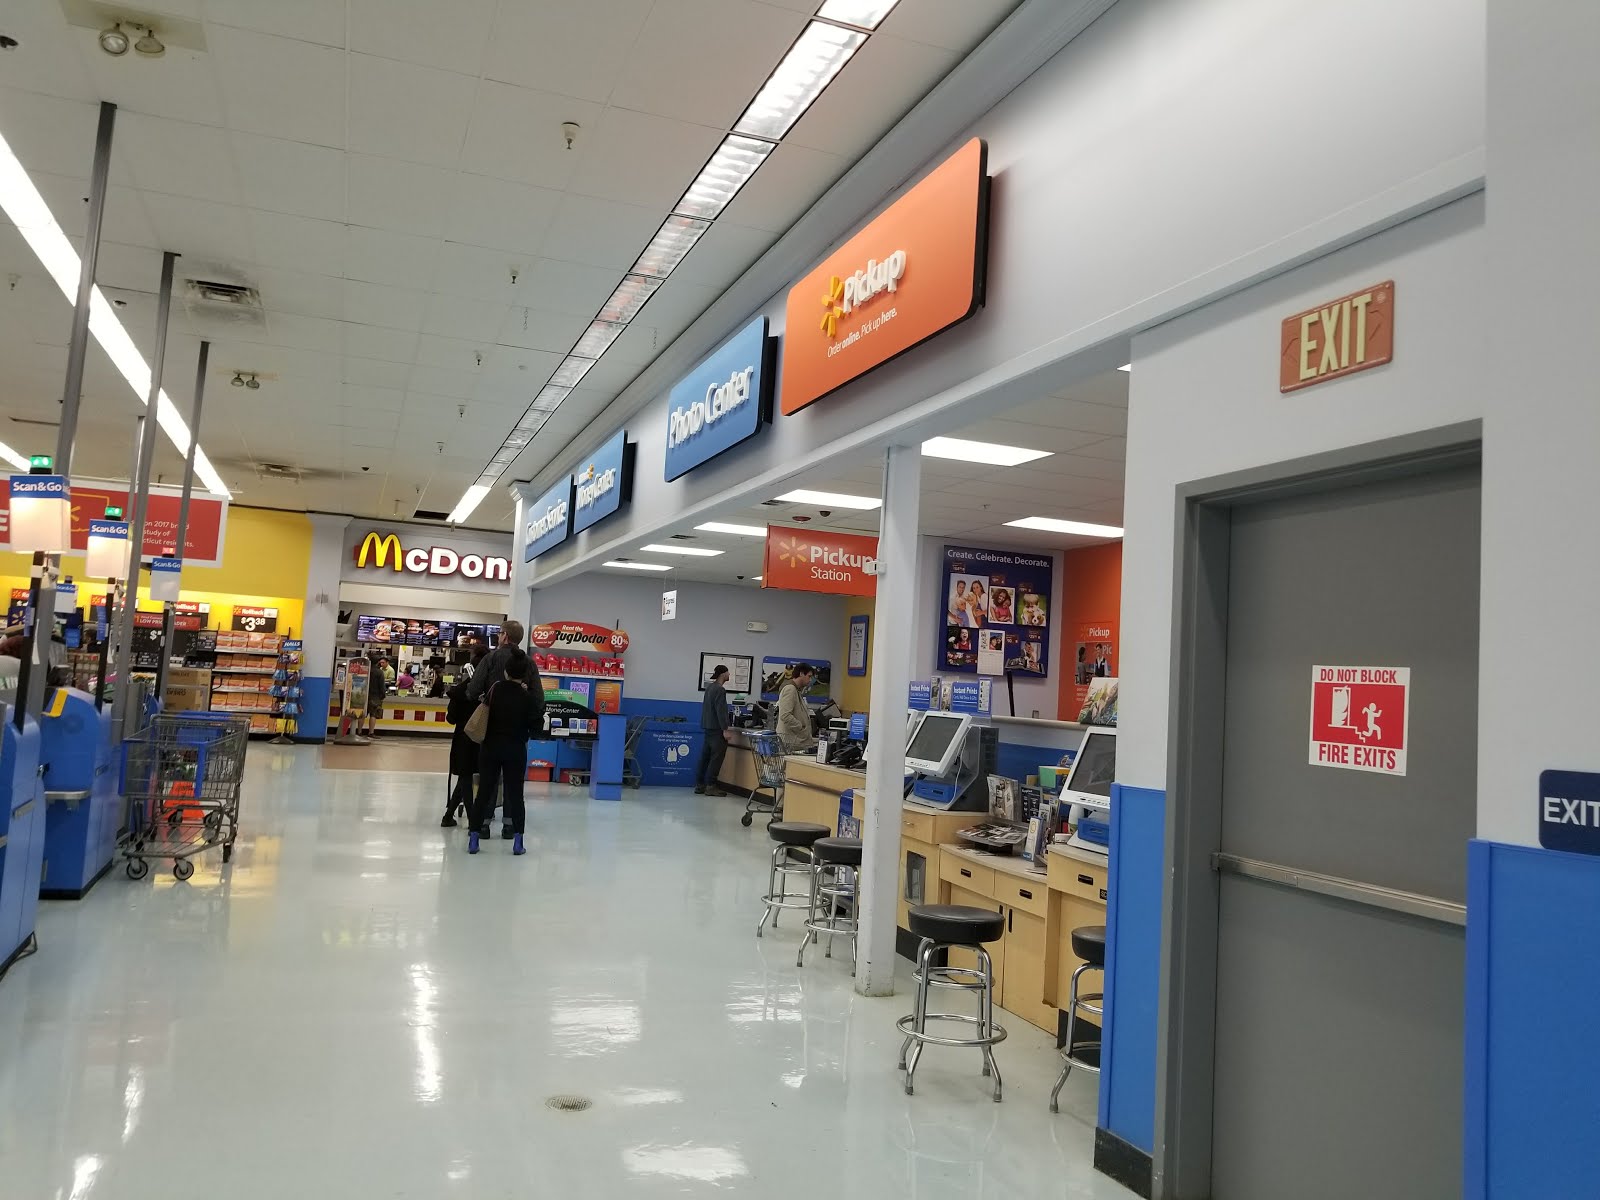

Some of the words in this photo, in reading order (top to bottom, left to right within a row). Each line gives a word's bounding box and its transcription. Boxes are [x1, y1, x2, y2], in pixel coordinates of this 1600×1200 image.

[843, 250, 907, 314] Pickup
[827, 342, 842, 358] Order
[841, 331, 861, 349] online.
[861, 320, 873, 338] Pick
[872, 317, 881, 331] up
[881, 307, 898, 324] here.
[1299, 292, 1372, 381] EXIT
[669, 401, 705, 449] Photo
[704, 366, 754, 424] Center
[13, 481, 62, 492] Scan&Go
[91, 524, 128, 535] Scan&Go
[153, 520, 169, 528] 2017
[143, 529, 162, 537] study
[357, 531, 513, 581] McDon
[810, 545, 874, 574] Pickup
[947, 549, 974, 560] Create.
[975, 552, 1014, 564] Celebrate.
[1014, 556, 1050, 568] Decorate.
[153, 560, 181, 569] Scan&Go
[810, 566, 852, 582] Station
[561, 624, 574, 632] Rent
[1088, 627, 1110, 639] Pickup
[1320, 668, 1334, 682] DO
[1337, 669, 1358, 683] NOT
[1361, 669, 1397, 684] BLOCK
[966, 687, 978, 695] Prints
[1318, 743, 1349, 764] FIRE
[1353, 746, 1396, 770] EXITS
[1543, 796, 1600, 828] EXIT
